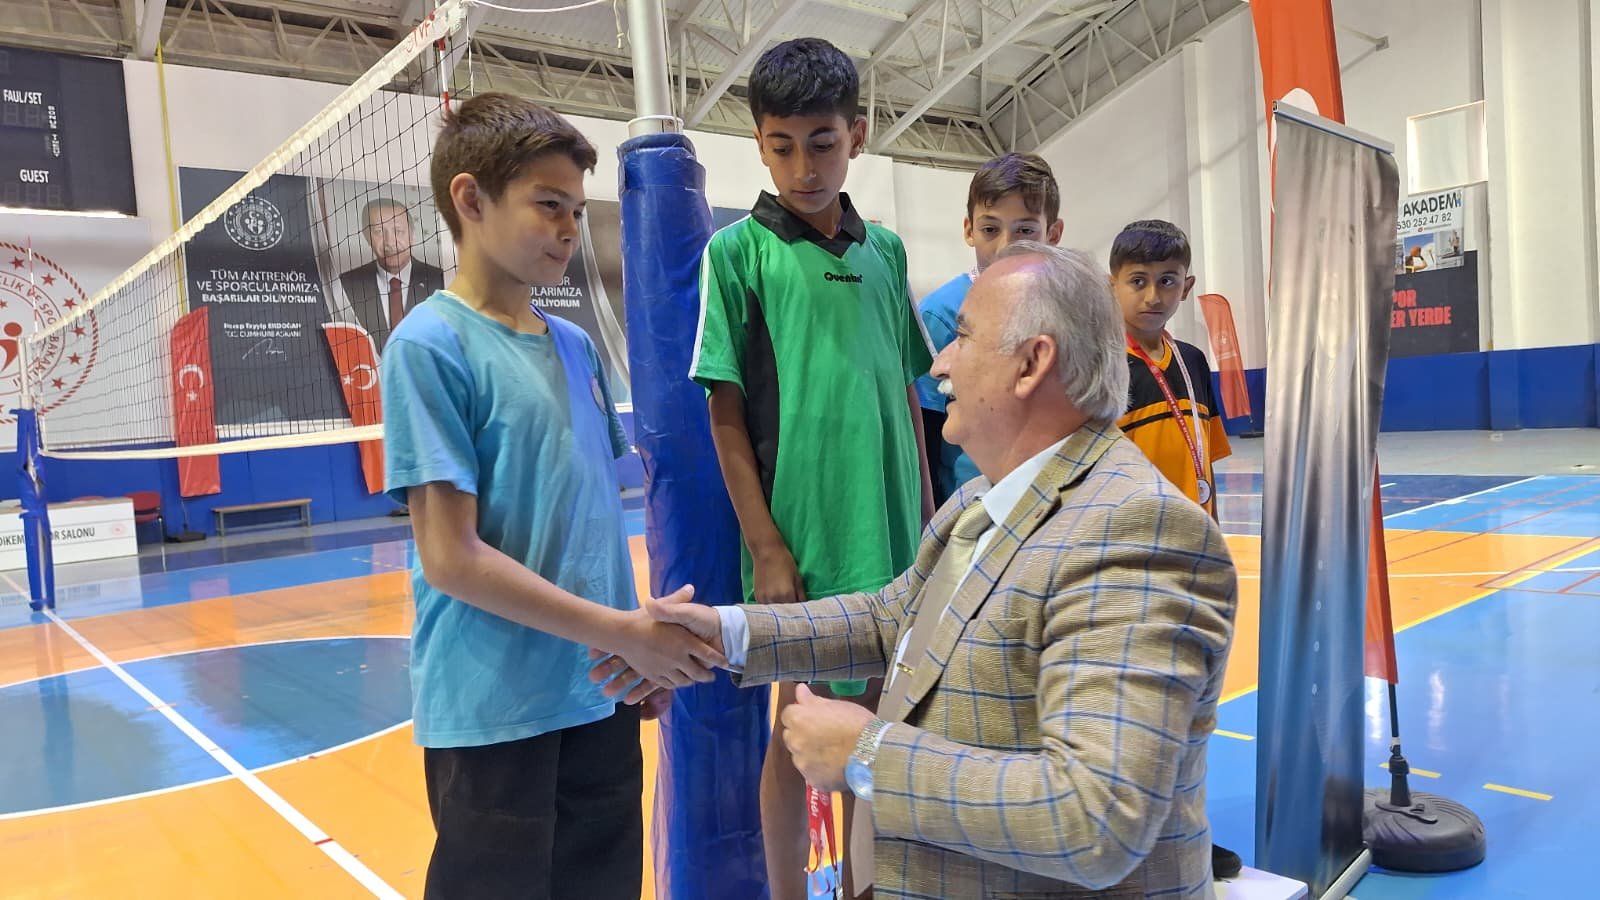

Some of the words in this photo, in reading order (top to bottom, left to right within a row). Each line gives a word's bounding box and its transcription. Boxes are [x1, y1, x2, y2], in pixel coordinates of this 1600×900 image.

[3, 88, 42, 105] FAUL/SET
[20, 168, 49, 183] GUEST
[1413, 217, 1428, 228] 252
[1429, 214, 1439, 225] 47
[210, 269, 239, 281] TÜM
[241, 270, 307, 282] ANTRENÖR
[197, 280, 212, 291] VE
[215, 281, 320, 293] SPORCULARIMIZA
[202, 293, 260, 304] BAŞARILAR
[531, 297, 580, 308] DİLİYORUM
[1409, 306, 1451, 327] YERDE
[62, 527, 95, 541] SALONU
